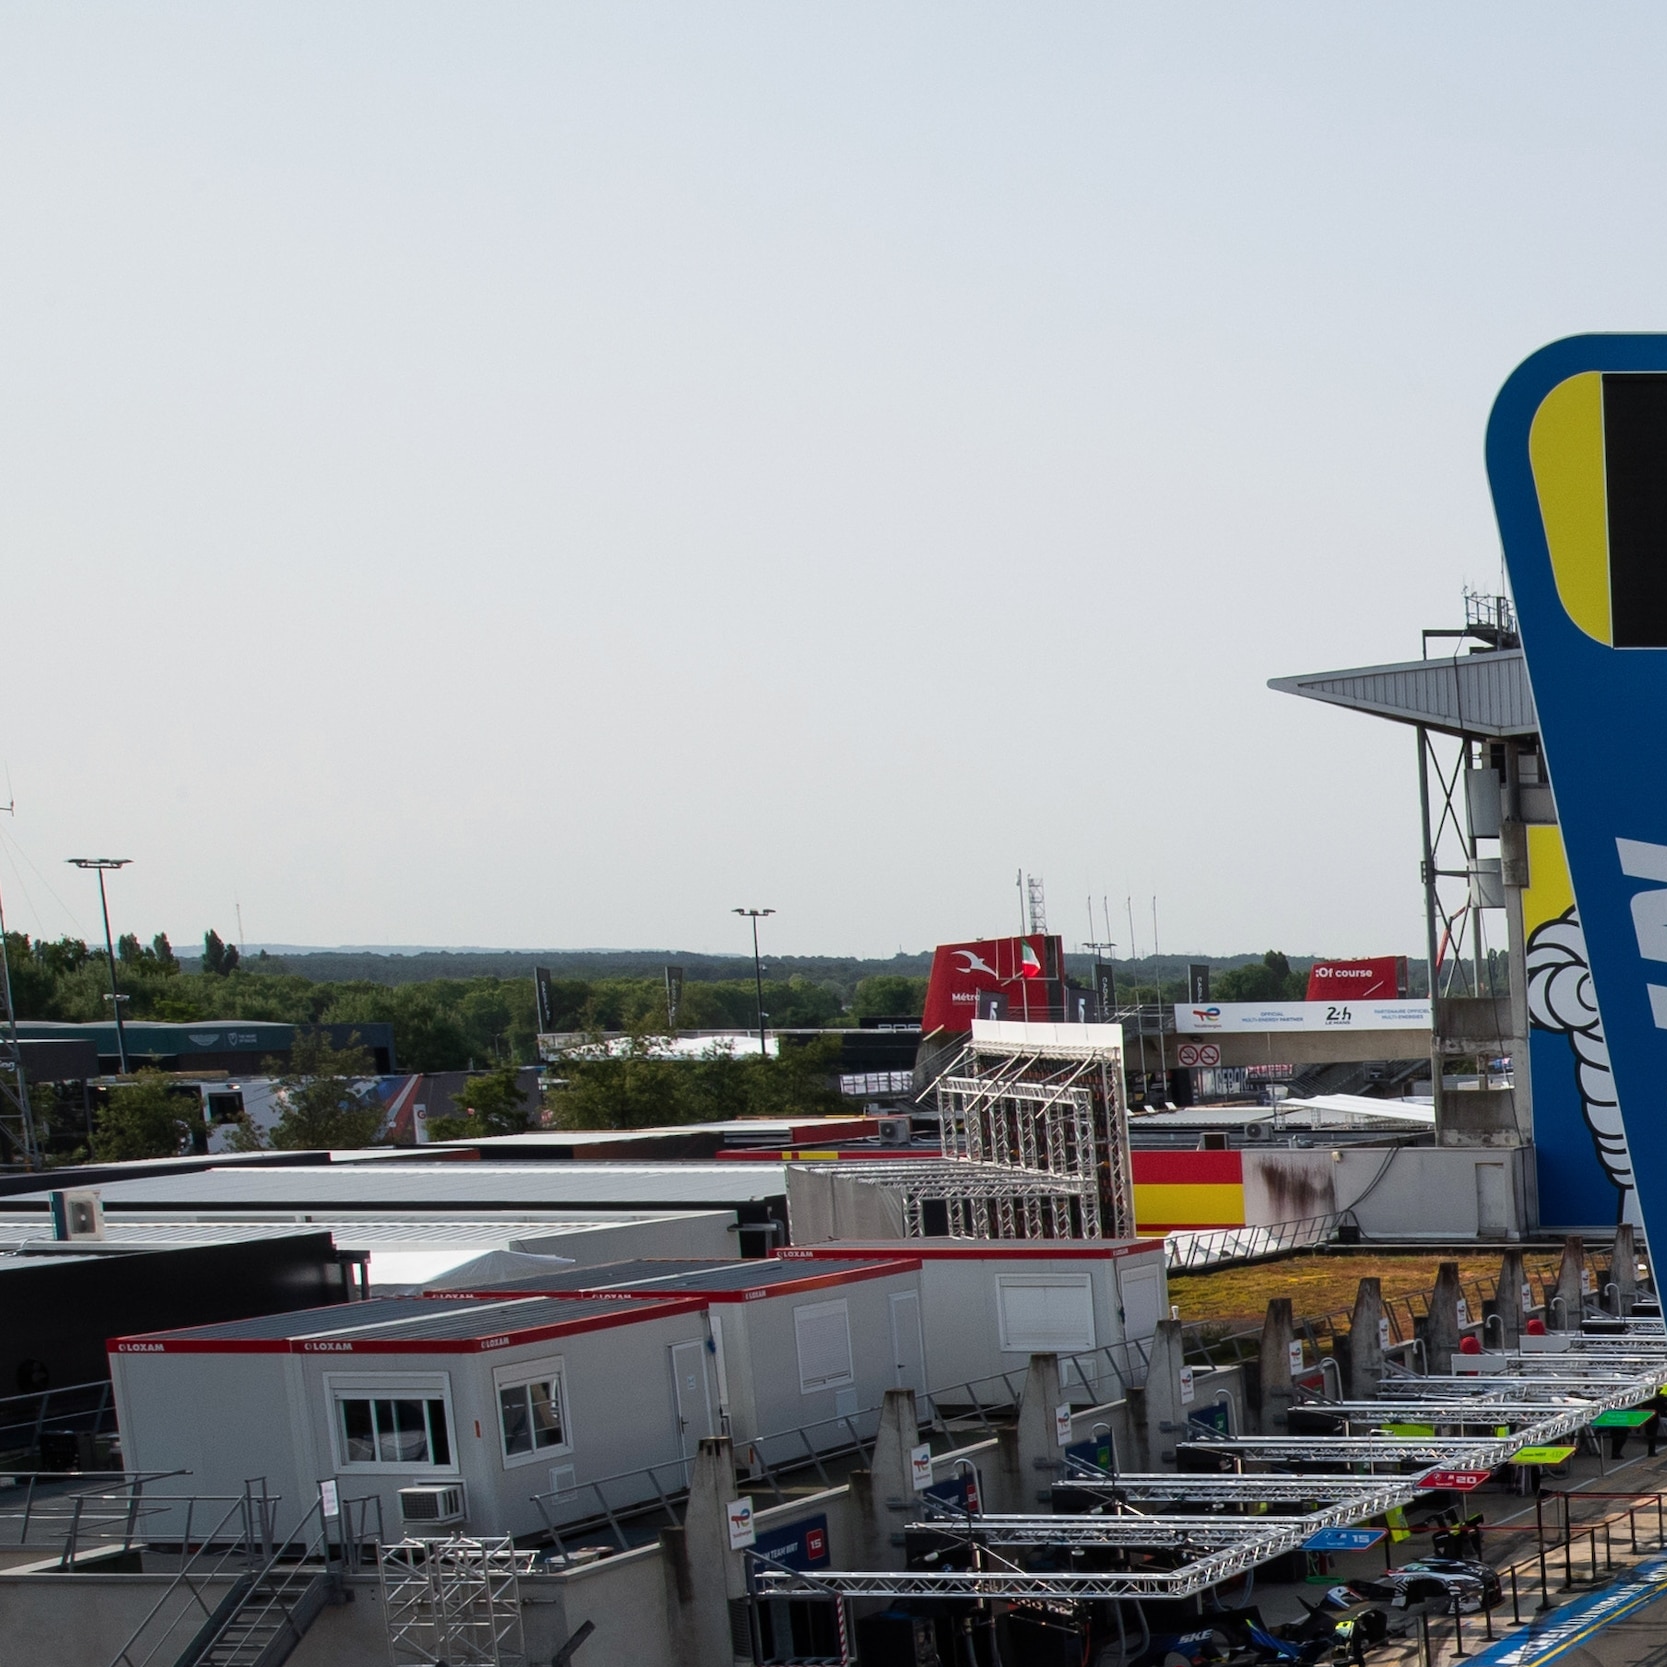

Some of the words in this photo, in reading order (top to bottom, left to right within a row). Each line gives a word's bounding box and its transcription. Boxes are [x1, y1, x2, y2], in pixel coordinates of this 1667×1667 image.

[1336, 968, 1373, 978] course
[127, 1343, 165, 1352] LOXAM
[313, 1342, 353, 1351] LOXAM
[486, 1336, 510, 1349] LOXAM
[1456, 1476, 1477, 1485] 20
[810, 1538, 822, 1550] 15
[1352, 1534, 1370, 1544] 15
